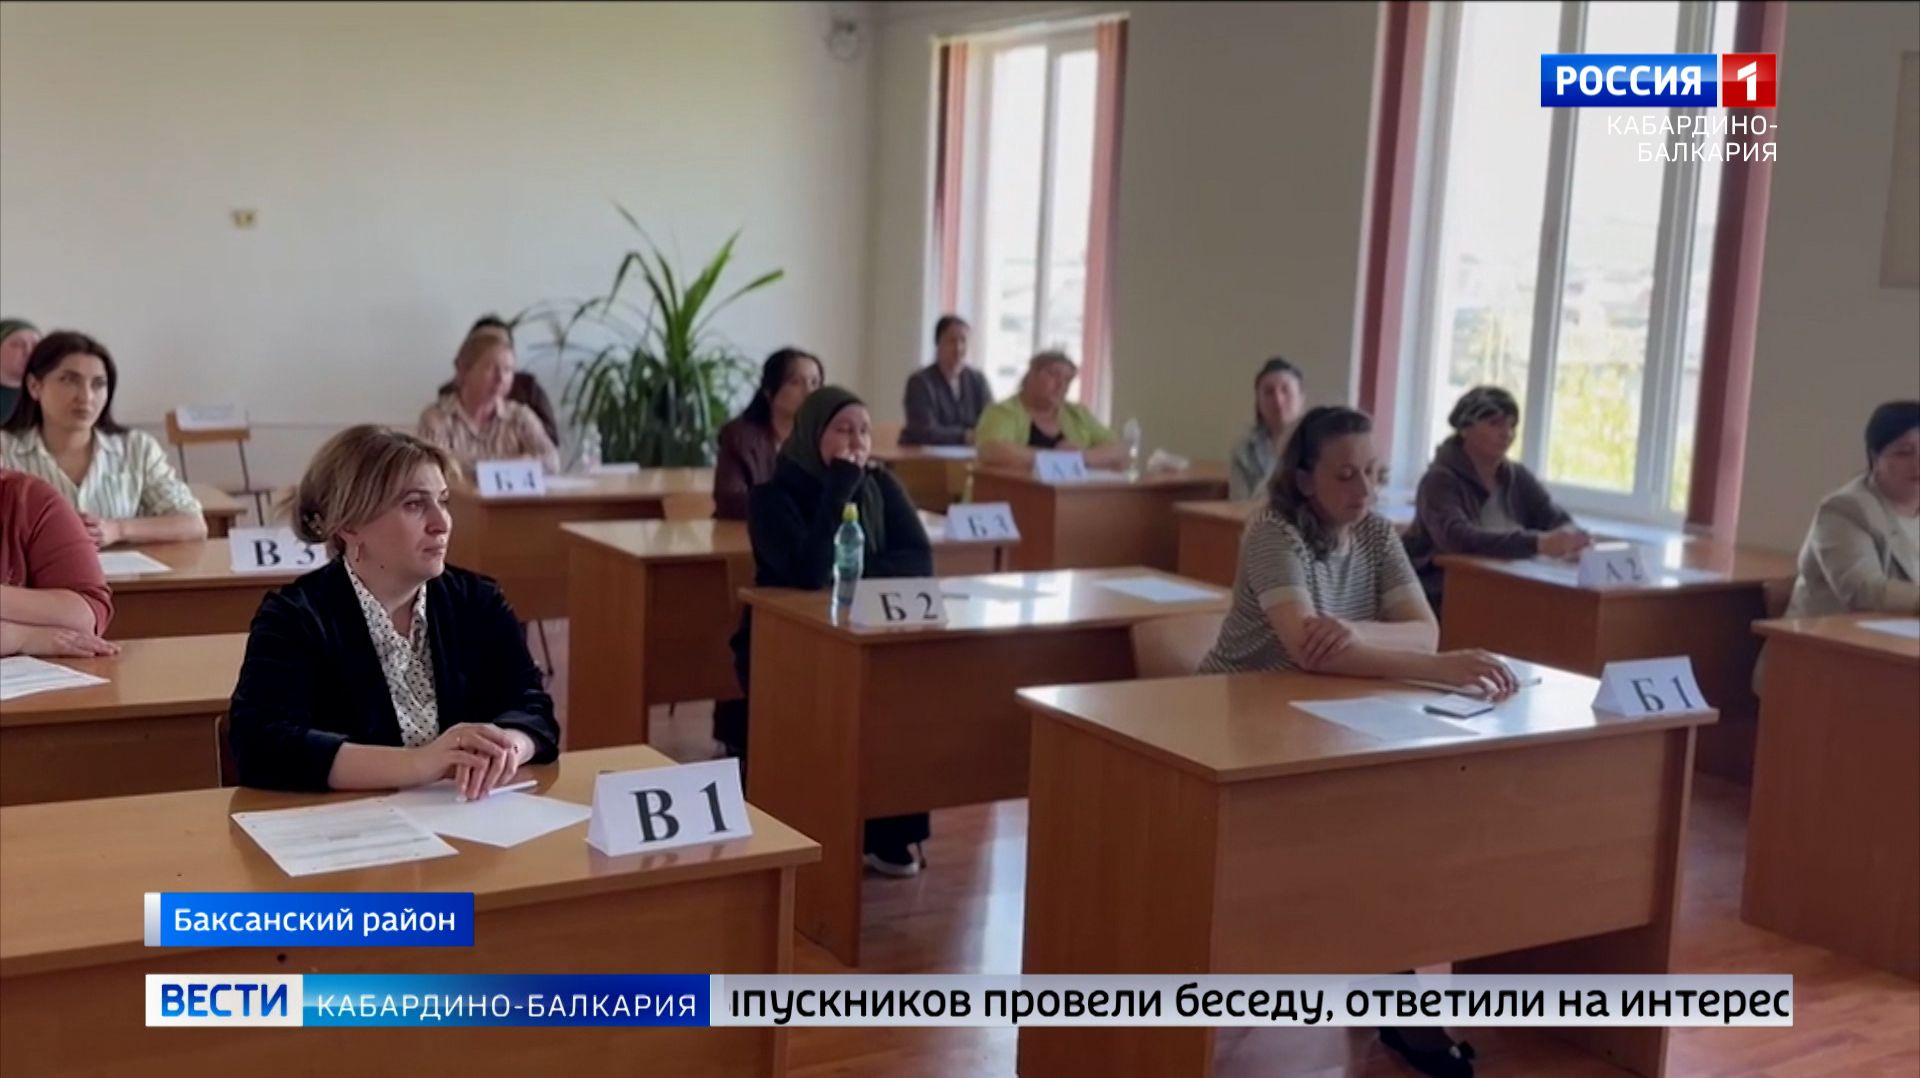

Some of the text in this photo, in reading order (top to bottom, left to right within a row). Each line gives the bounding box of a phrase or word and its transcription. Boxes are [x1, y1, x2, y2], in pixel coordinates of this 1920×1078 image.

[251, 538, 282, 567] В
[1623, 556, 1642, 581] 2
[878, 591, 939, 622] Б 2
[1630, 675, 1693, 713] Б 1
[629, 780, 730, 844] В 1
